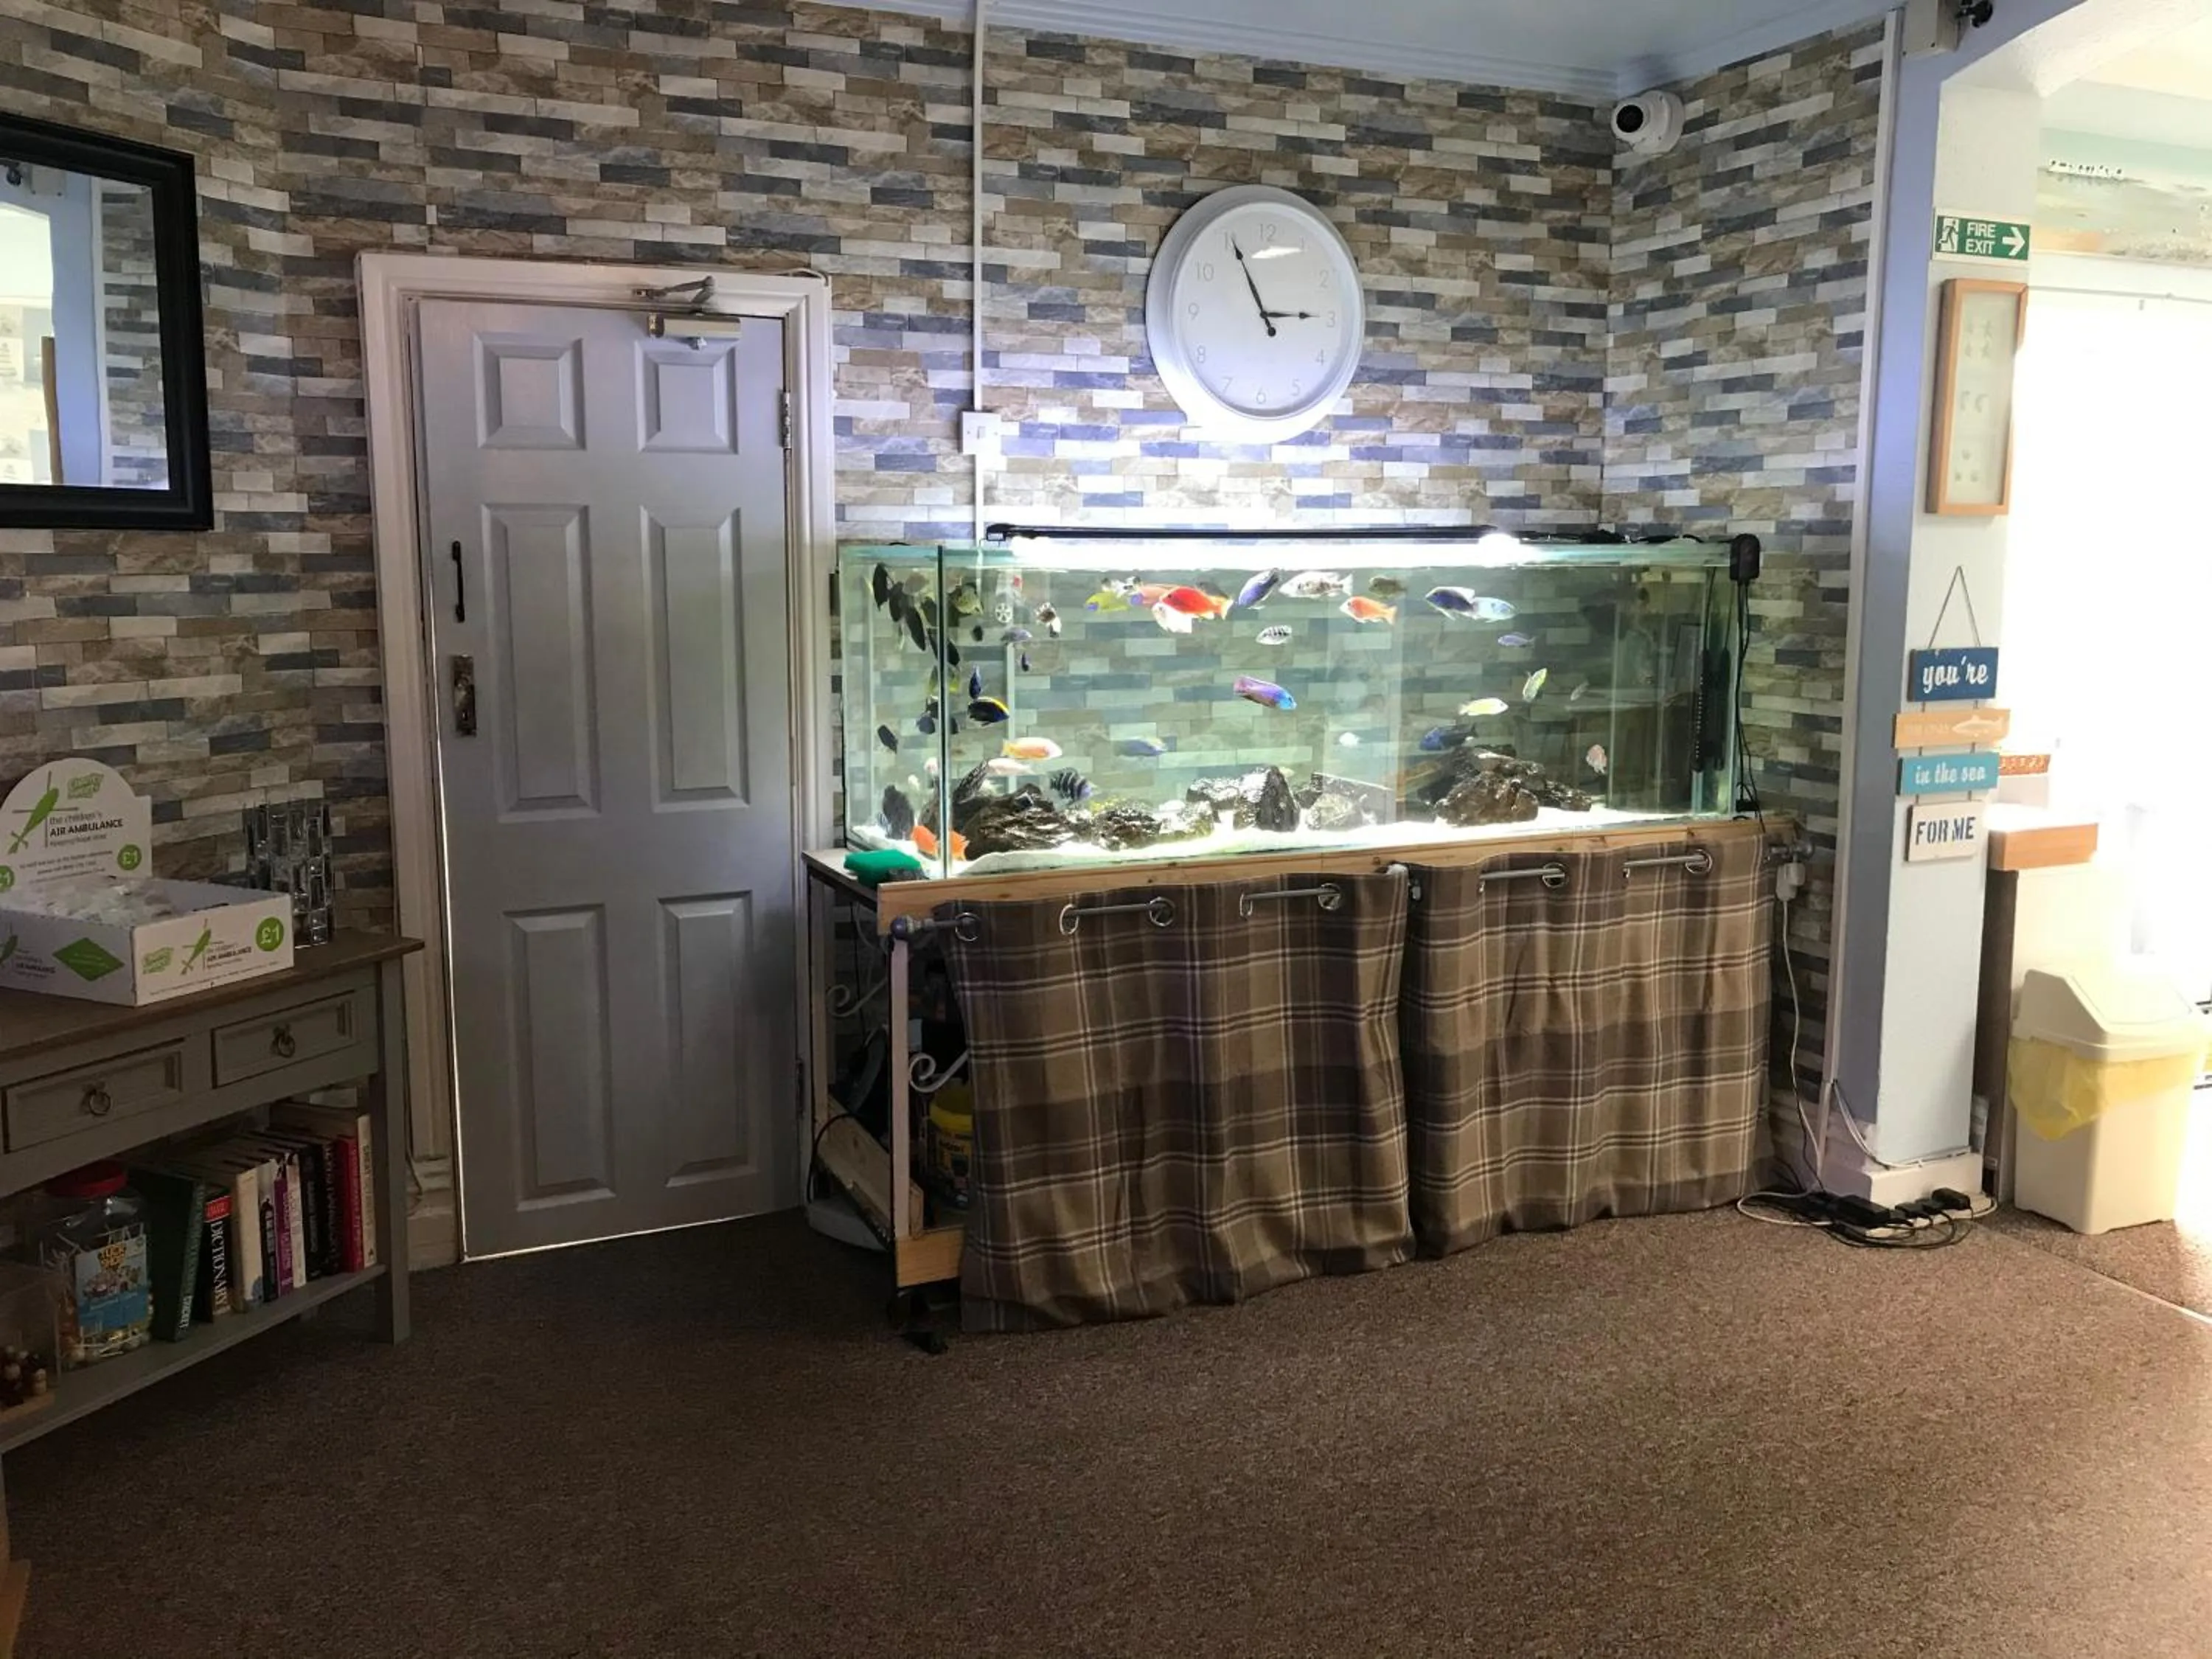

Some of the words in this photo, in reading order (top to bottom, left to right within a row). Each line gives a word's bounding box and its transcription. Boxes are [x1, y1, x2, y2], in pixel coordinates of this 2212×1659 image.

[1259, 223, 1276, 242] 12
[1966, 222, 1996, 238] FIRE
[1965, 238, 1995, 254] EXIT
[1195, 262, 1214, 282] 10
[1319, 271, 1328, 288] 2
[1189, 302, 1200, 320] 9
[1327, 311, 1336, 327] 3
[1197, 346, 1206, 364] 8
[1315, 349, 1325, 366] 4
[1222, 377, 1234, 394] 7
[1256, 388, 1267, 405] 6
[1922, 655, 1989, 693] you're
[1915, 765, 1930, 785] in
[1934, 762, 1958, 784] the
[1961, 768, 1986, 782] sea
[49, 827, 66, 838] AIR
[68, 818, 124, 833] AMBULANCE
[1915, 819, 1949, 846] FOR
[1952, 816, 1977, 841] ME
[260, 923, 280, 945] £1
[211, 1221, 228, 1307] DICTIONARY
